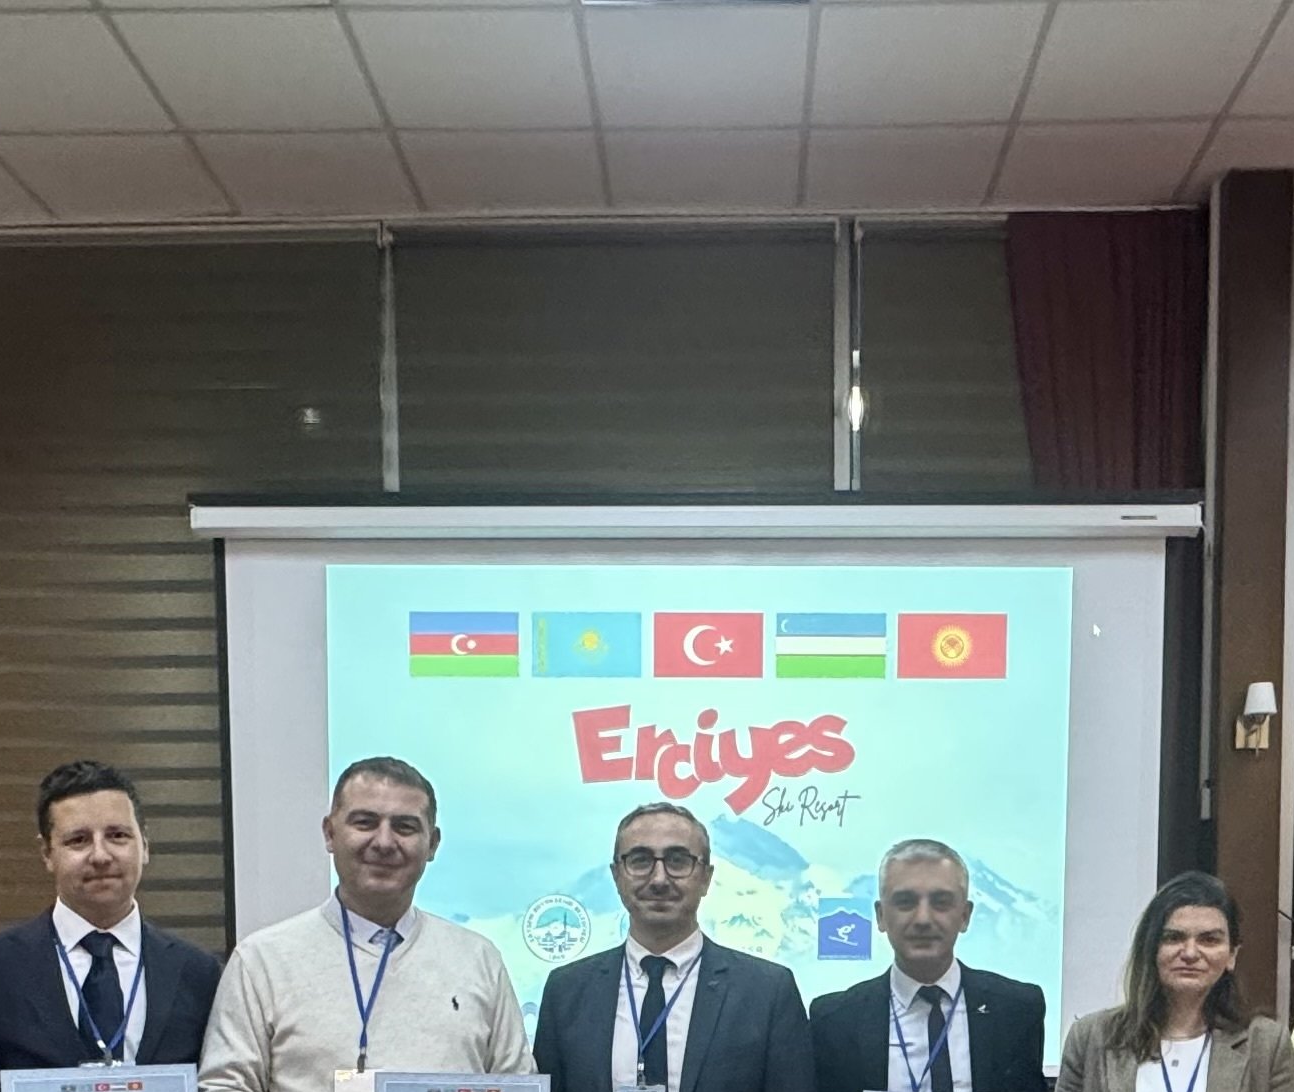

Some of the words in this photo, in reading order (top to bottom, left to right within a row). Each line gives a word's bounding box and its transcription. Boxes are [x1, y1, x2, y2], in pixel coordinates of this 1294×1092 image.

[572, 704, 855, 816] Erciyes
[762, 787, 794, 826] Ski
[799, 785, 861, 827] Resort
